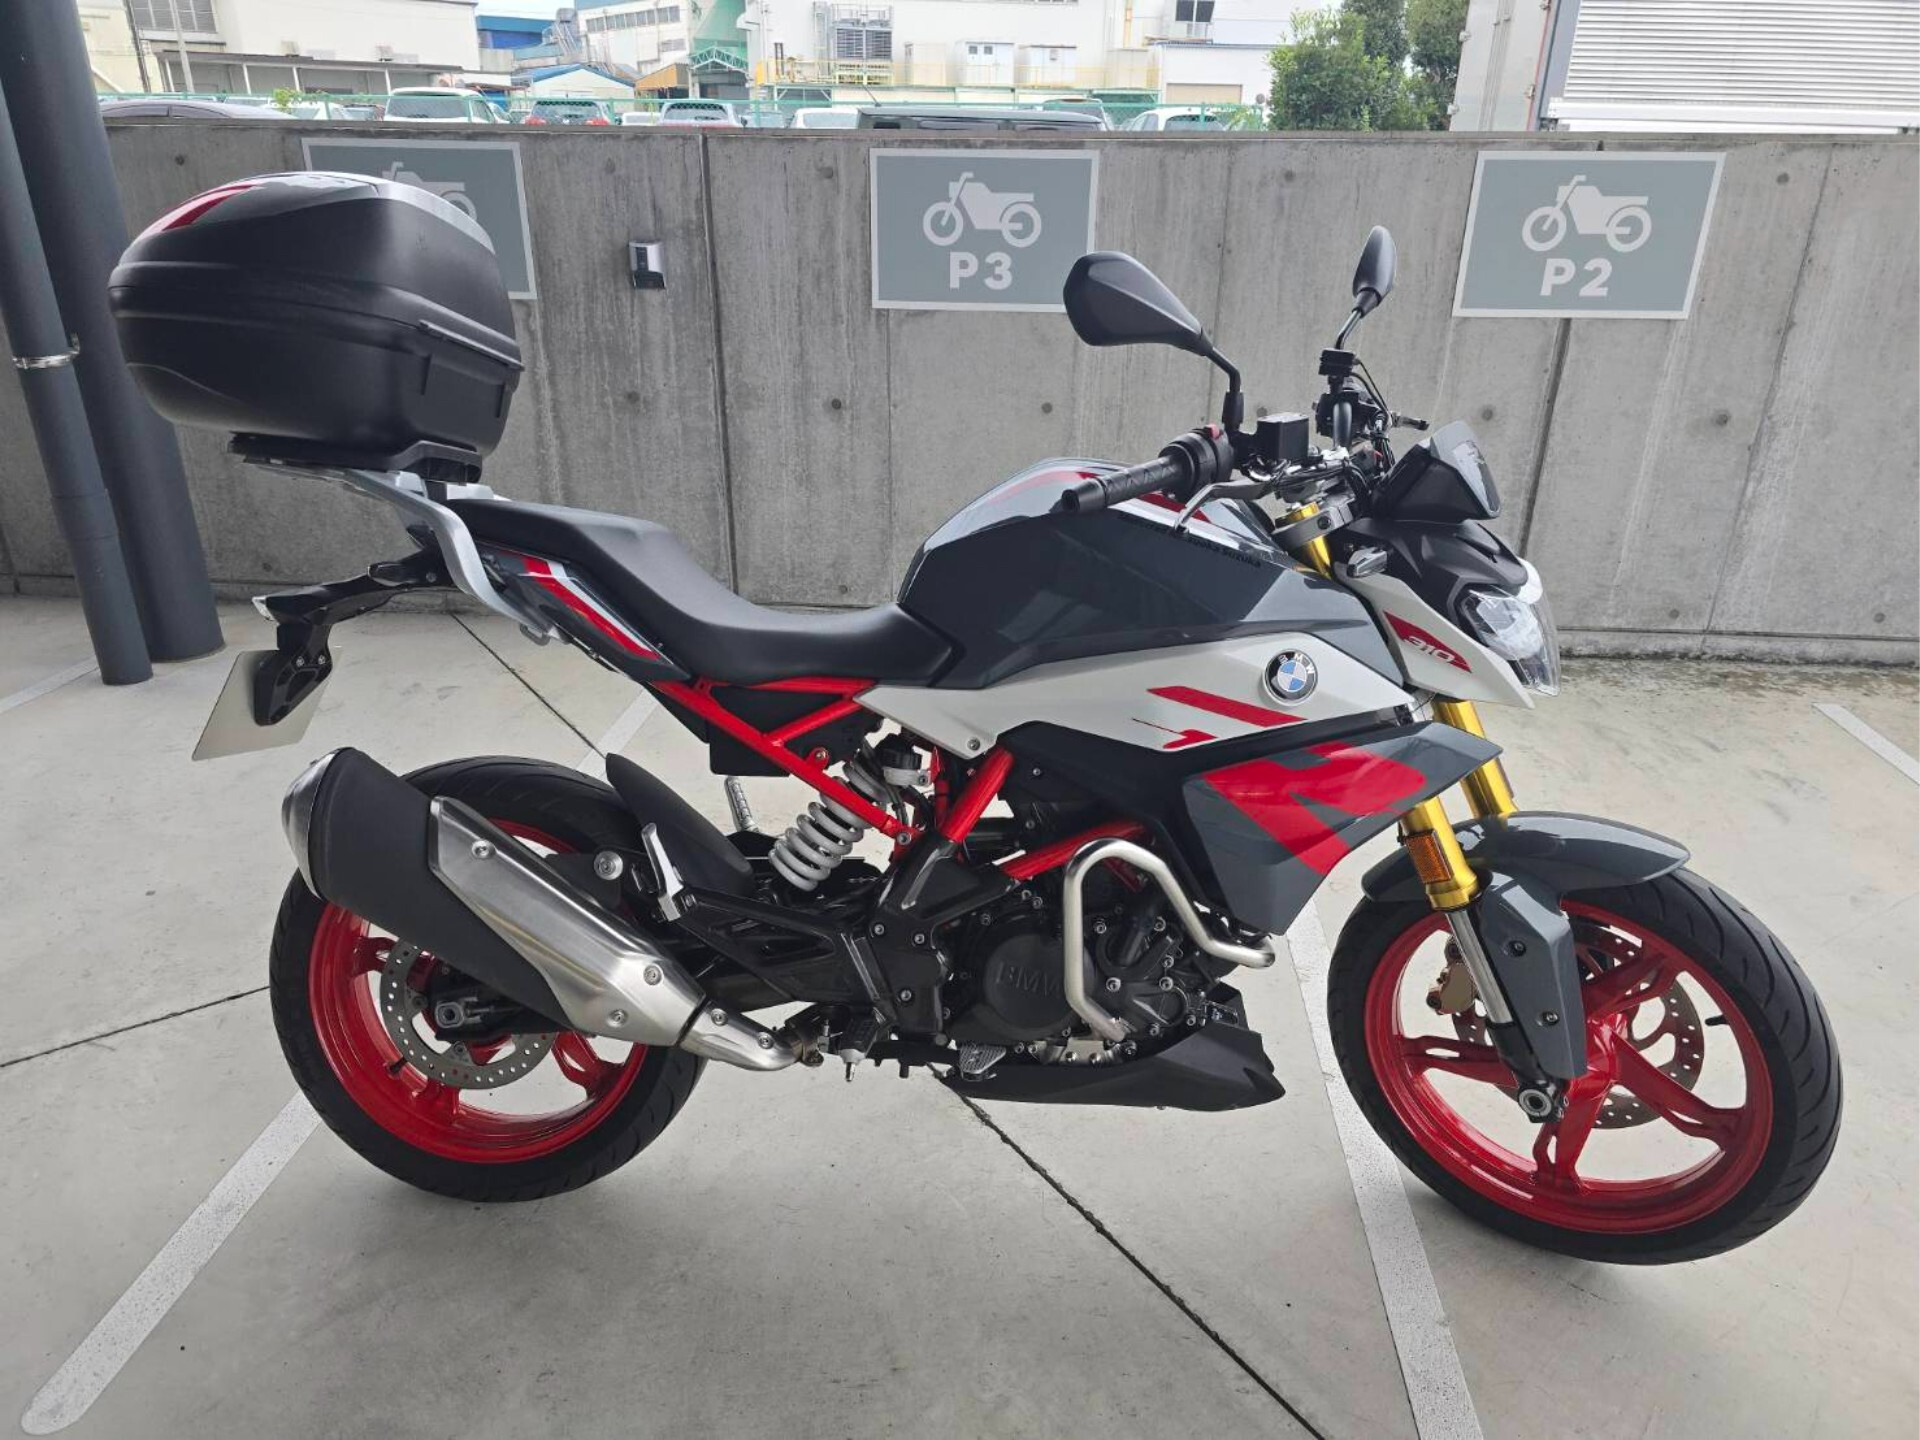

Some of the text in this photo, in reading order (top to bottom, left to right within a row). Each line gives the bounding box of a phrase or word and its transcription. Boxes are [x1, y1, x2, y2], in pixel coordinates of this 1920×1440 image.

[950, 251, 1012, 290] P3
[1540, 257, 1612, 297] P2
[1403, 635, 1455, 663] 310
